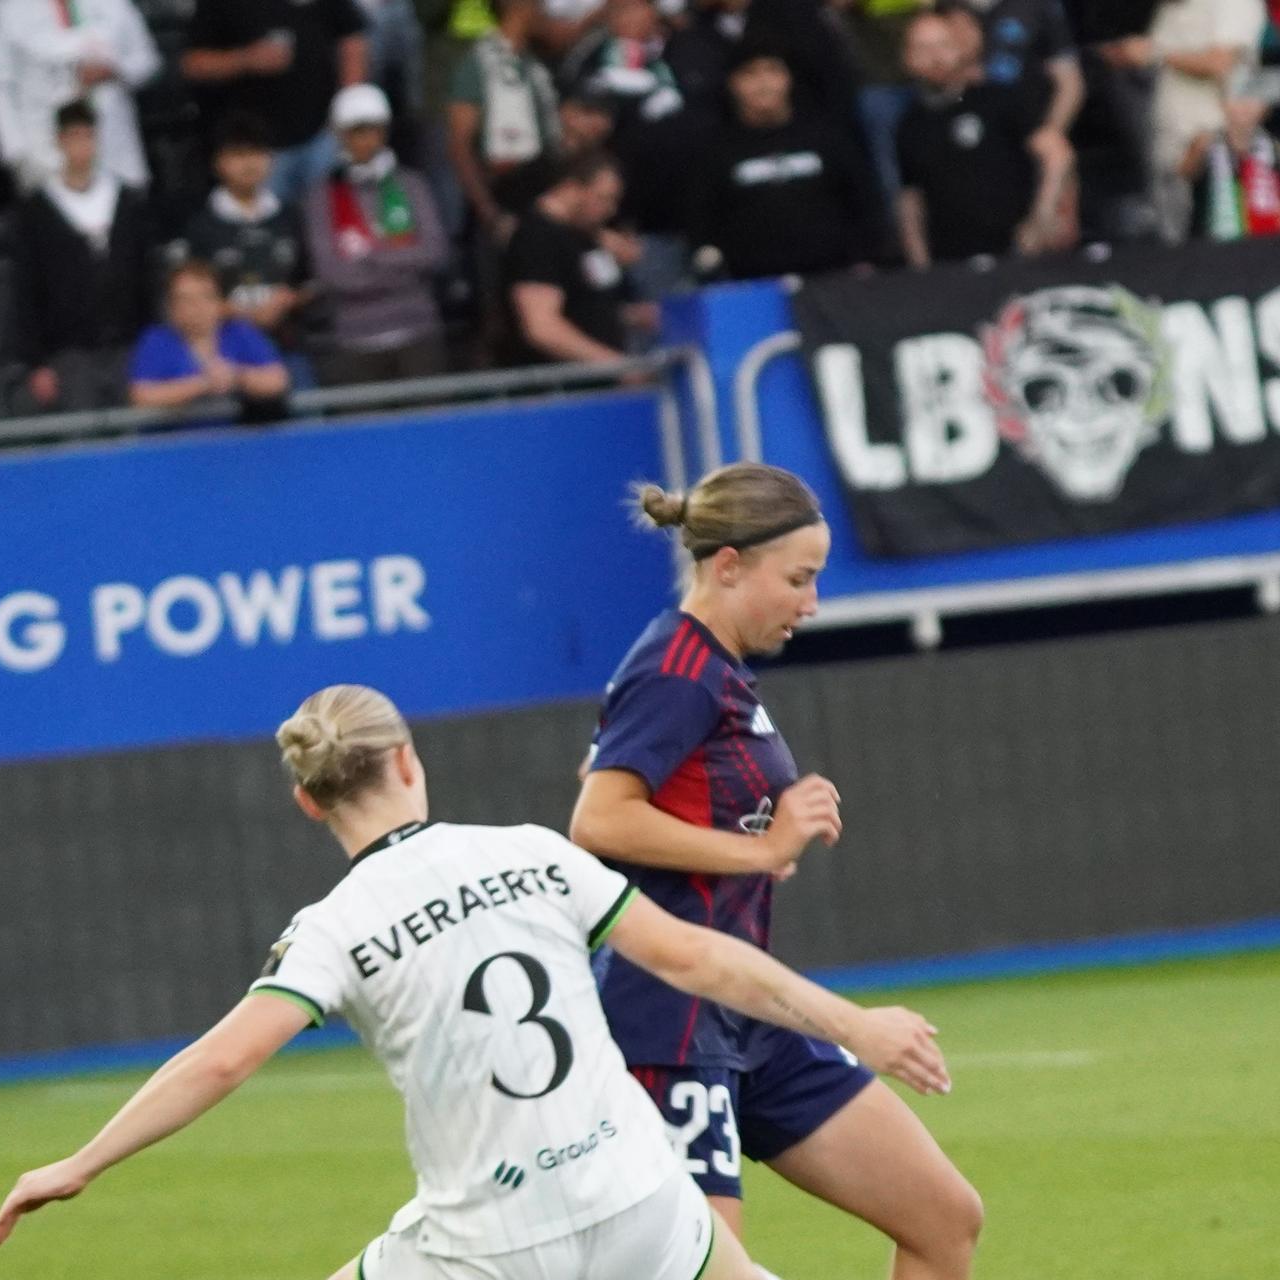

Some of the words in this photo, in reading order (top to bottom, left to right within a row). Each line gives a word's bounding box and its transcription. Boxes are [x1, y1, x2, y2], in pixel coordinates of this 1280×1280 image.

[90, 554, 431, 662] POWER
[349, 864, 571, 980] EVERAERTS
[462, 951, 575, 1100] 3
[670, 1081, 741, 1177] 23
